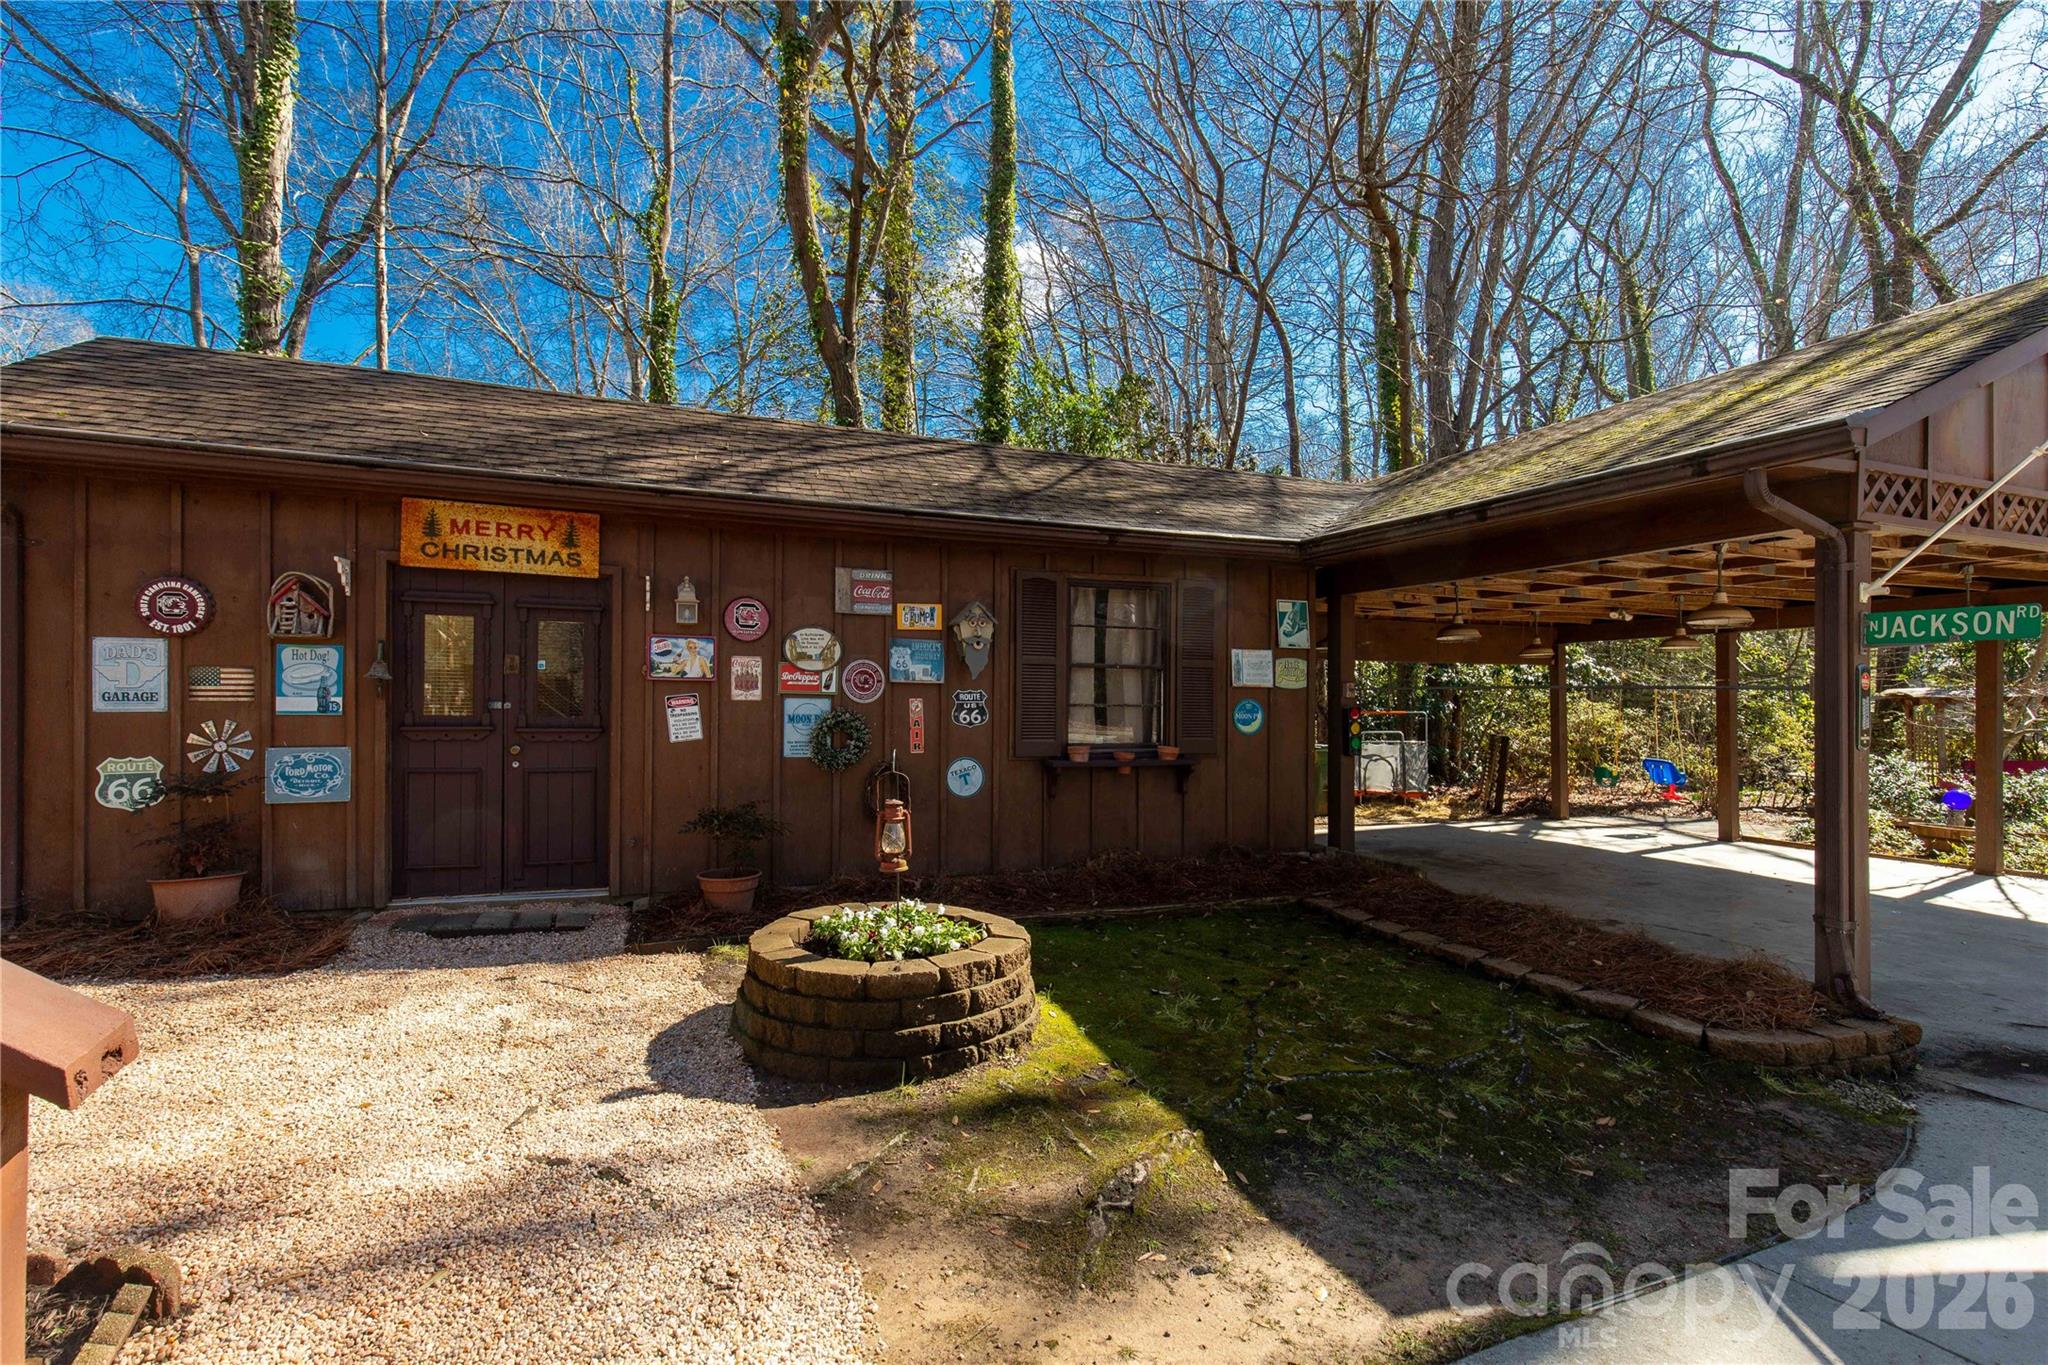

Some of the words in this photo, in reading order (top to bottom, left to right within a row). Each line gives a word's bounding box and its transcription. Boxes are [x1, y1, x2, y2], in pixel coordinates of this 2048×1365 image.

[450, 518, 557, 541] MERRY
[420, 541, 583, 567] CHRISTMAS
[144, 581, 181, 596] CAROLINA
[140, 594, 150, 617] SOUTH
[182, 584, 206, 620] GAMECOCKS
[149, 619, 170, 633] EST.
[171, 620, 197, 633] 1801
[1869, 620, 1878, 632] N
[1874, 610, 2016, 639] JACKSON
[2016, 605, 2040, 618] RD
[103, 645, 158, 662] DAD'S
[291, 648, 307, 662] Hot
[310, 650, 330, 665] Dog!
[896, 659, 908, 668] 66
[102, 691, 158, 702] GARAGE
[788, 713, 812, 724] MOON
[959, 709, 982, 724] 66
[913, 719, 921, 750] AIR
[107, 761, 154, 772] ROUTE
[285, 766, 306, 777] FORD
[306, 763, 333, 773] MOTOR
[950, 764, 977, 777] TEXACO
[958, 772, 971, 785] T
[107, 777, 153, 803] 66
